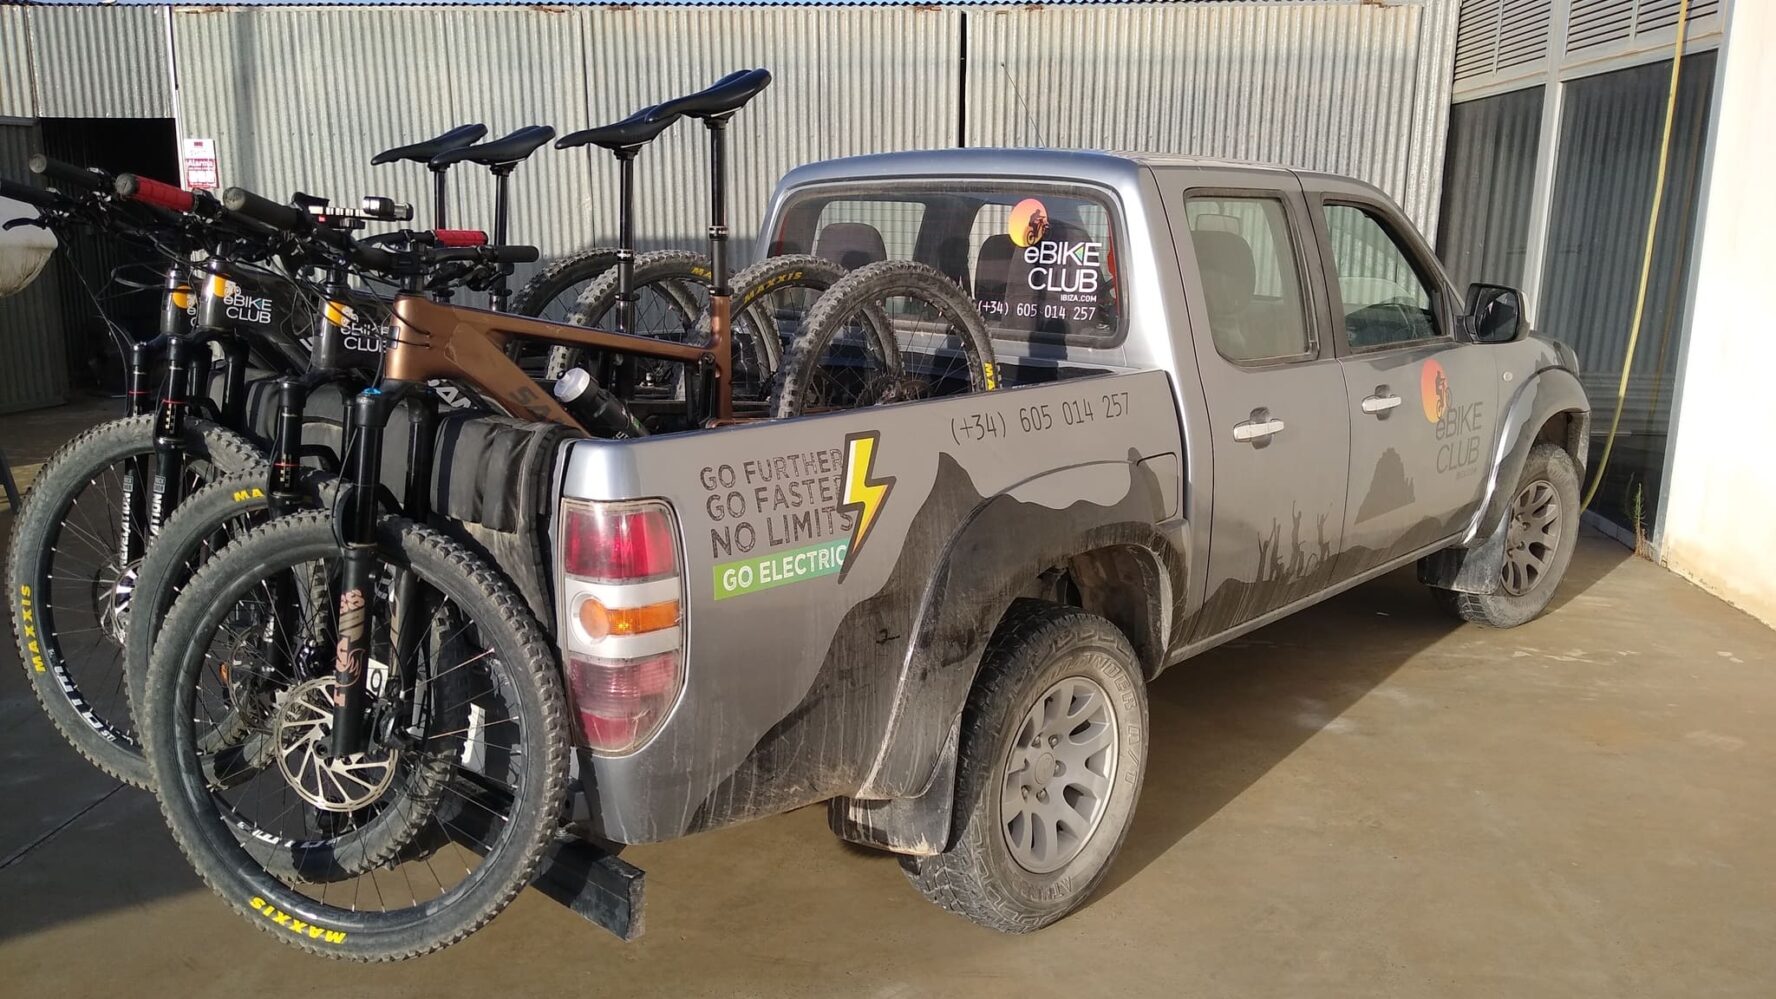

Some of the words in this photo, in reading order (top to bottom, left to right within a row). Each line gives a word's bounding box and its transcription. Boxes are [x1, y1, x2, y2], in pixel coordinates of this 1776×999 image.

[1024, 241, 1102, 266] eBIKE
[743, 271, 803, 303] MAXXIS
[1028, 267, 1098, 292] CLUB
[223, 294, 272, 312] eBIKE
[226, 307, 271, 324] CLUB
[1016, 303, 1038, 317] 605
[1044, 304, 1066, 320] 014
[1073, 307, 1096, 320] 257
[1060, 294, 1097, 303] IBIZA.COM
[951, 411, 1006, 446] (+34)
[1019, 404, 1053, 433] 605
[1062, 398, 1094, 426] 014
[1102, 392, 1129, 418] 257
[1436, 401, 1483, 441] eBIKE
[700, 464, 737, 491] GO
[743, 448, 843, 484] FURTHER
[1436, 436, 1480, 474] CLUB
[706, 491, 746, 521] GO
[710, 521, 756, 558] NO
[766, 505, 854, 547] LIMITS
[723, 565, 753, 591] GO
[759, 545, 848, 584] ELECTRIC
[20, 584, 47, 673] MAXXIS
[249, 896, 347, 944] MAXXIS
